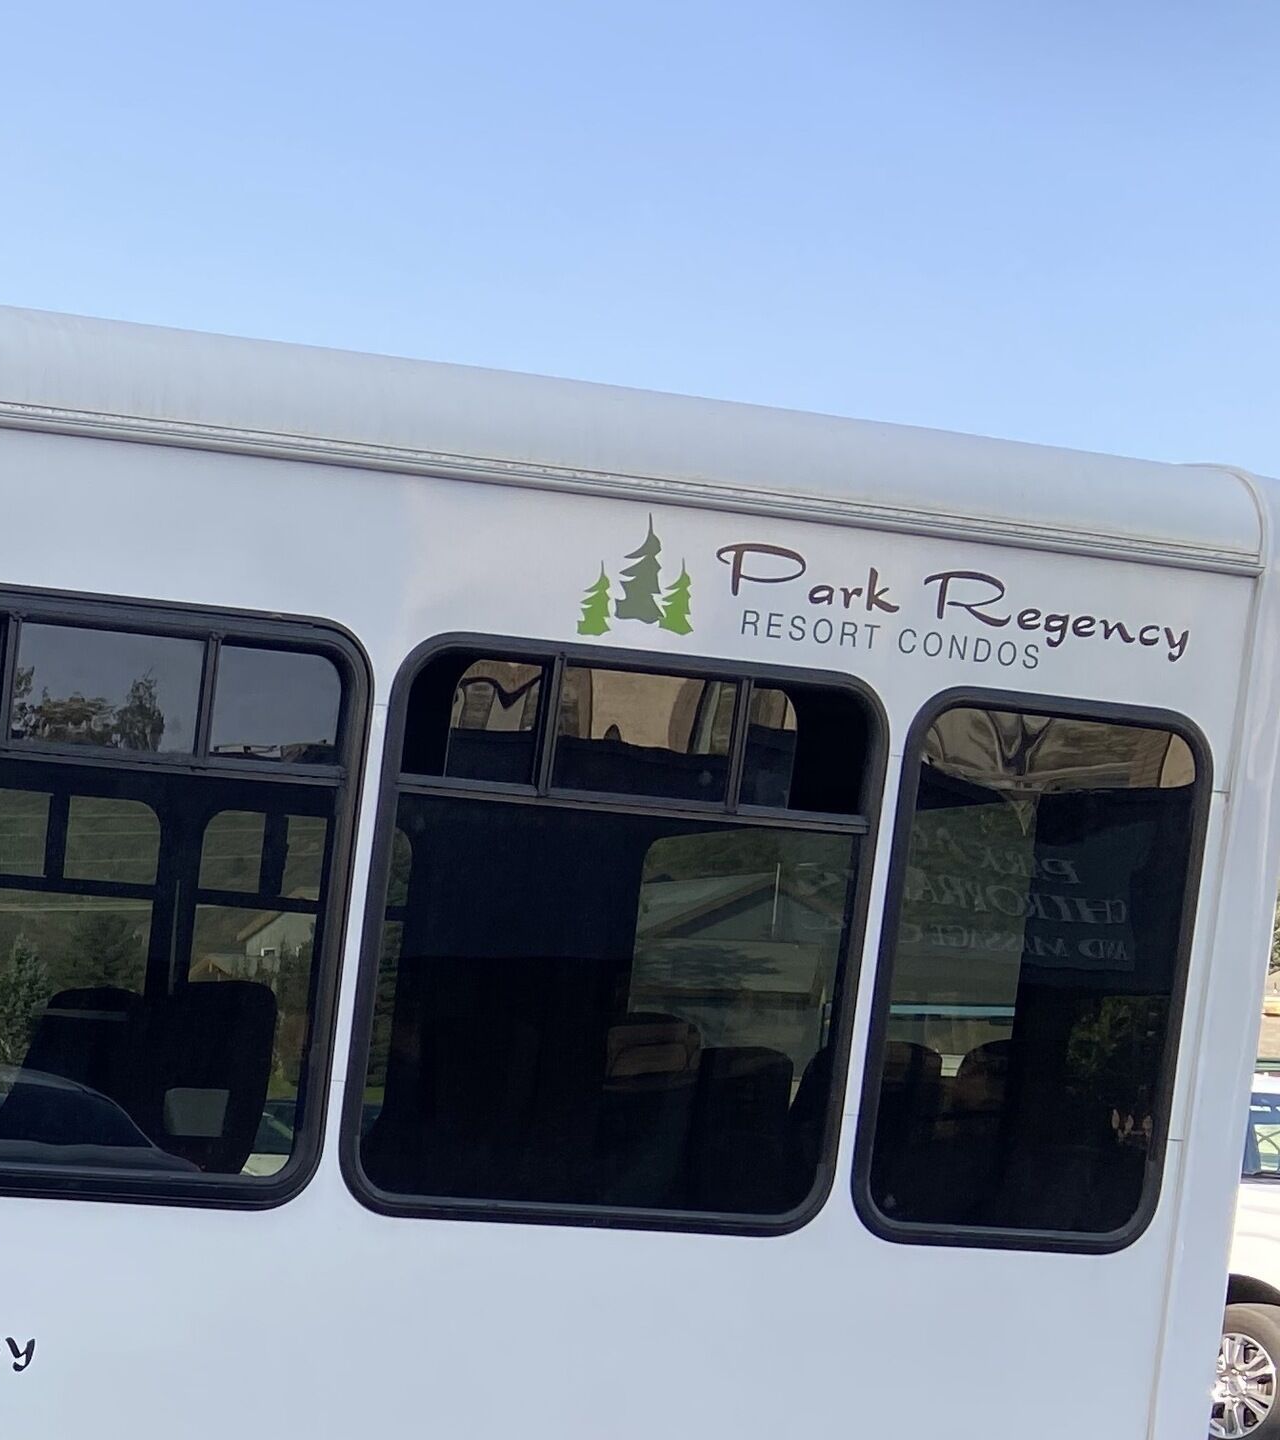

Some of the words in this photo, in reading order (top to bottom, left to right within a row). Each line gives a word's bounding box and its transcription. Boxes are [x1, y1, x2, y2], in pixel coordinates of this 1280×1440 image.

[716, 542, 900, 615] Park
[923, 569, 1190, 663] Regency
[740, 608, 883, 651] RESORT
[897, 628, 1041, 670] CONDOS
